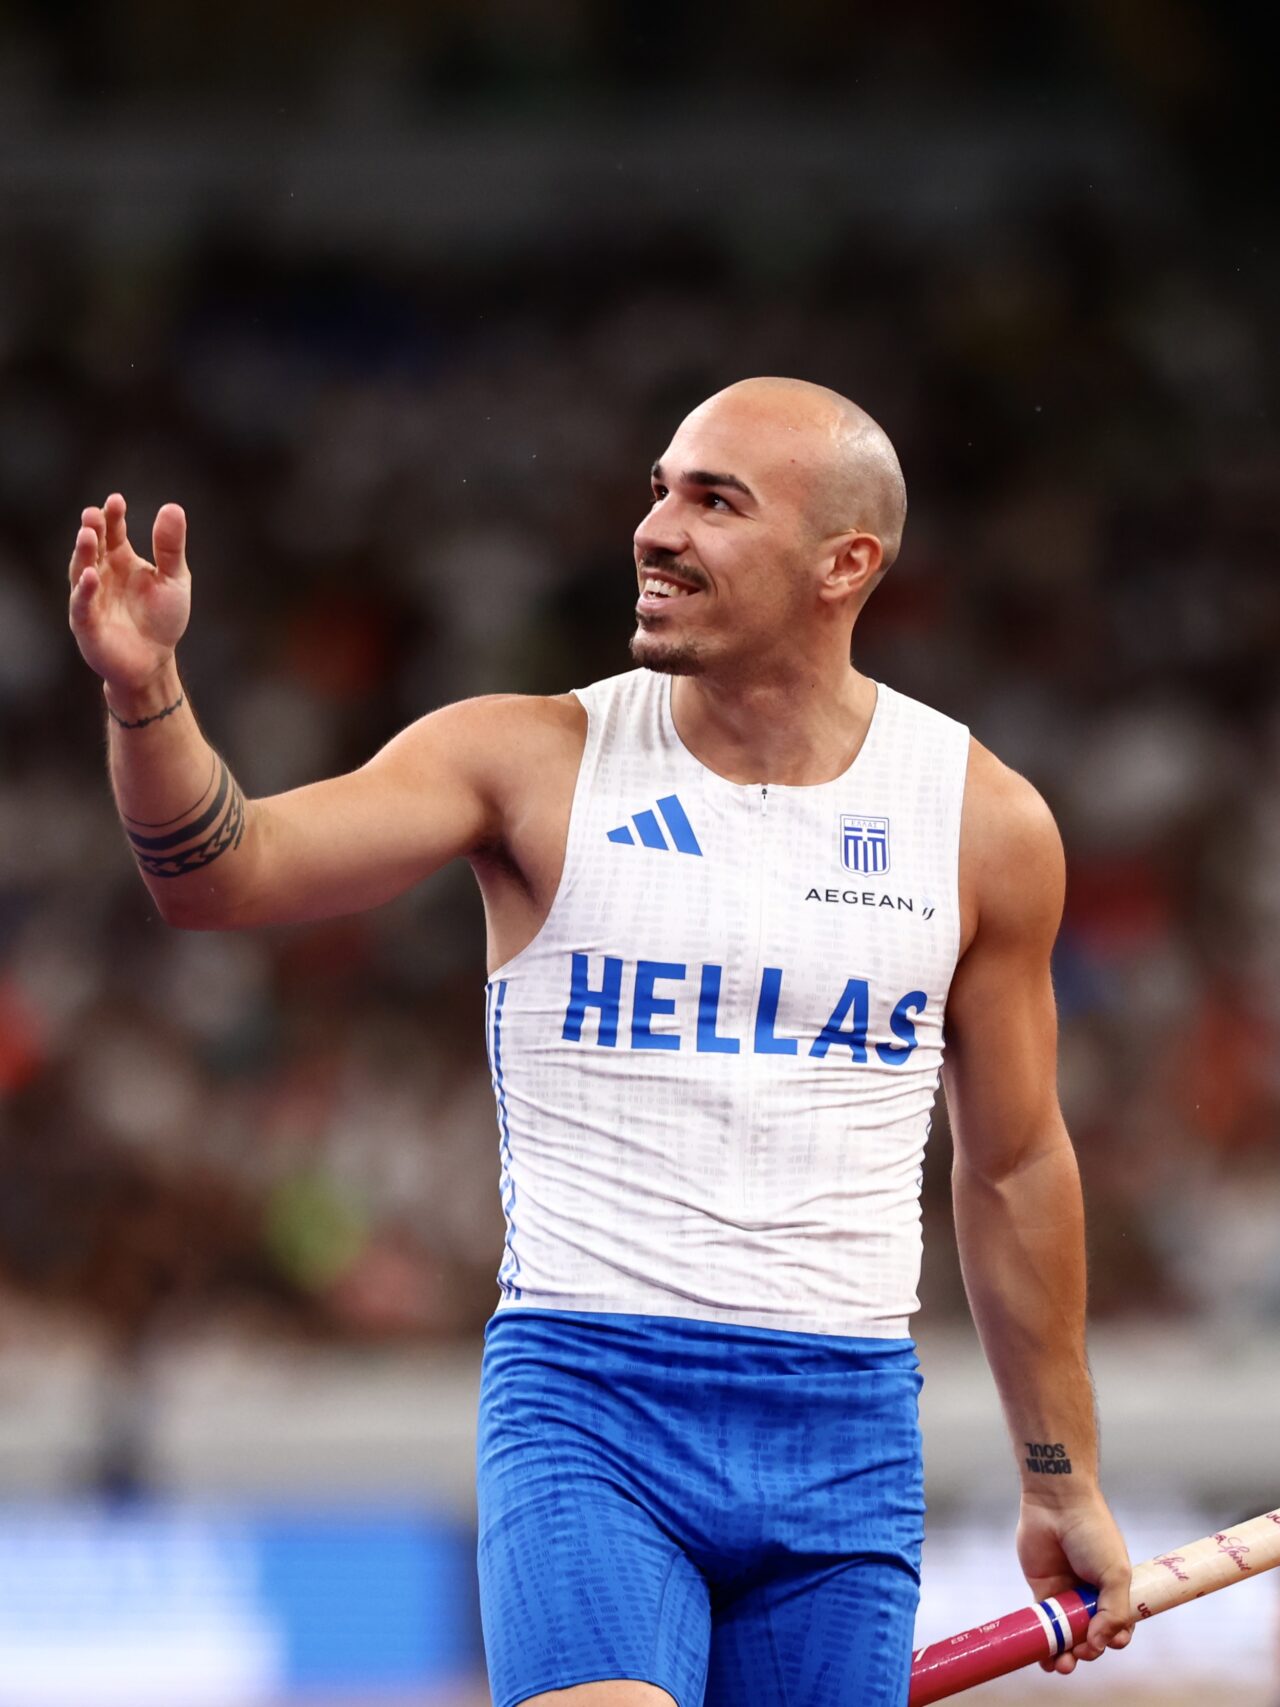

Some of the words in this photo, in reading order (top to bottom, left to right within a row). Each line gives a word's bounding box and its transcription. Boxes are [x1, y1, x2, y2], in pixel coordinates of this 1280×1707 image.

[805, 887, 914, 912] AEGEAN
[562, 952, 928, 1066] HELLAS
[1025, 1443, 1066, 1459] SOUL
